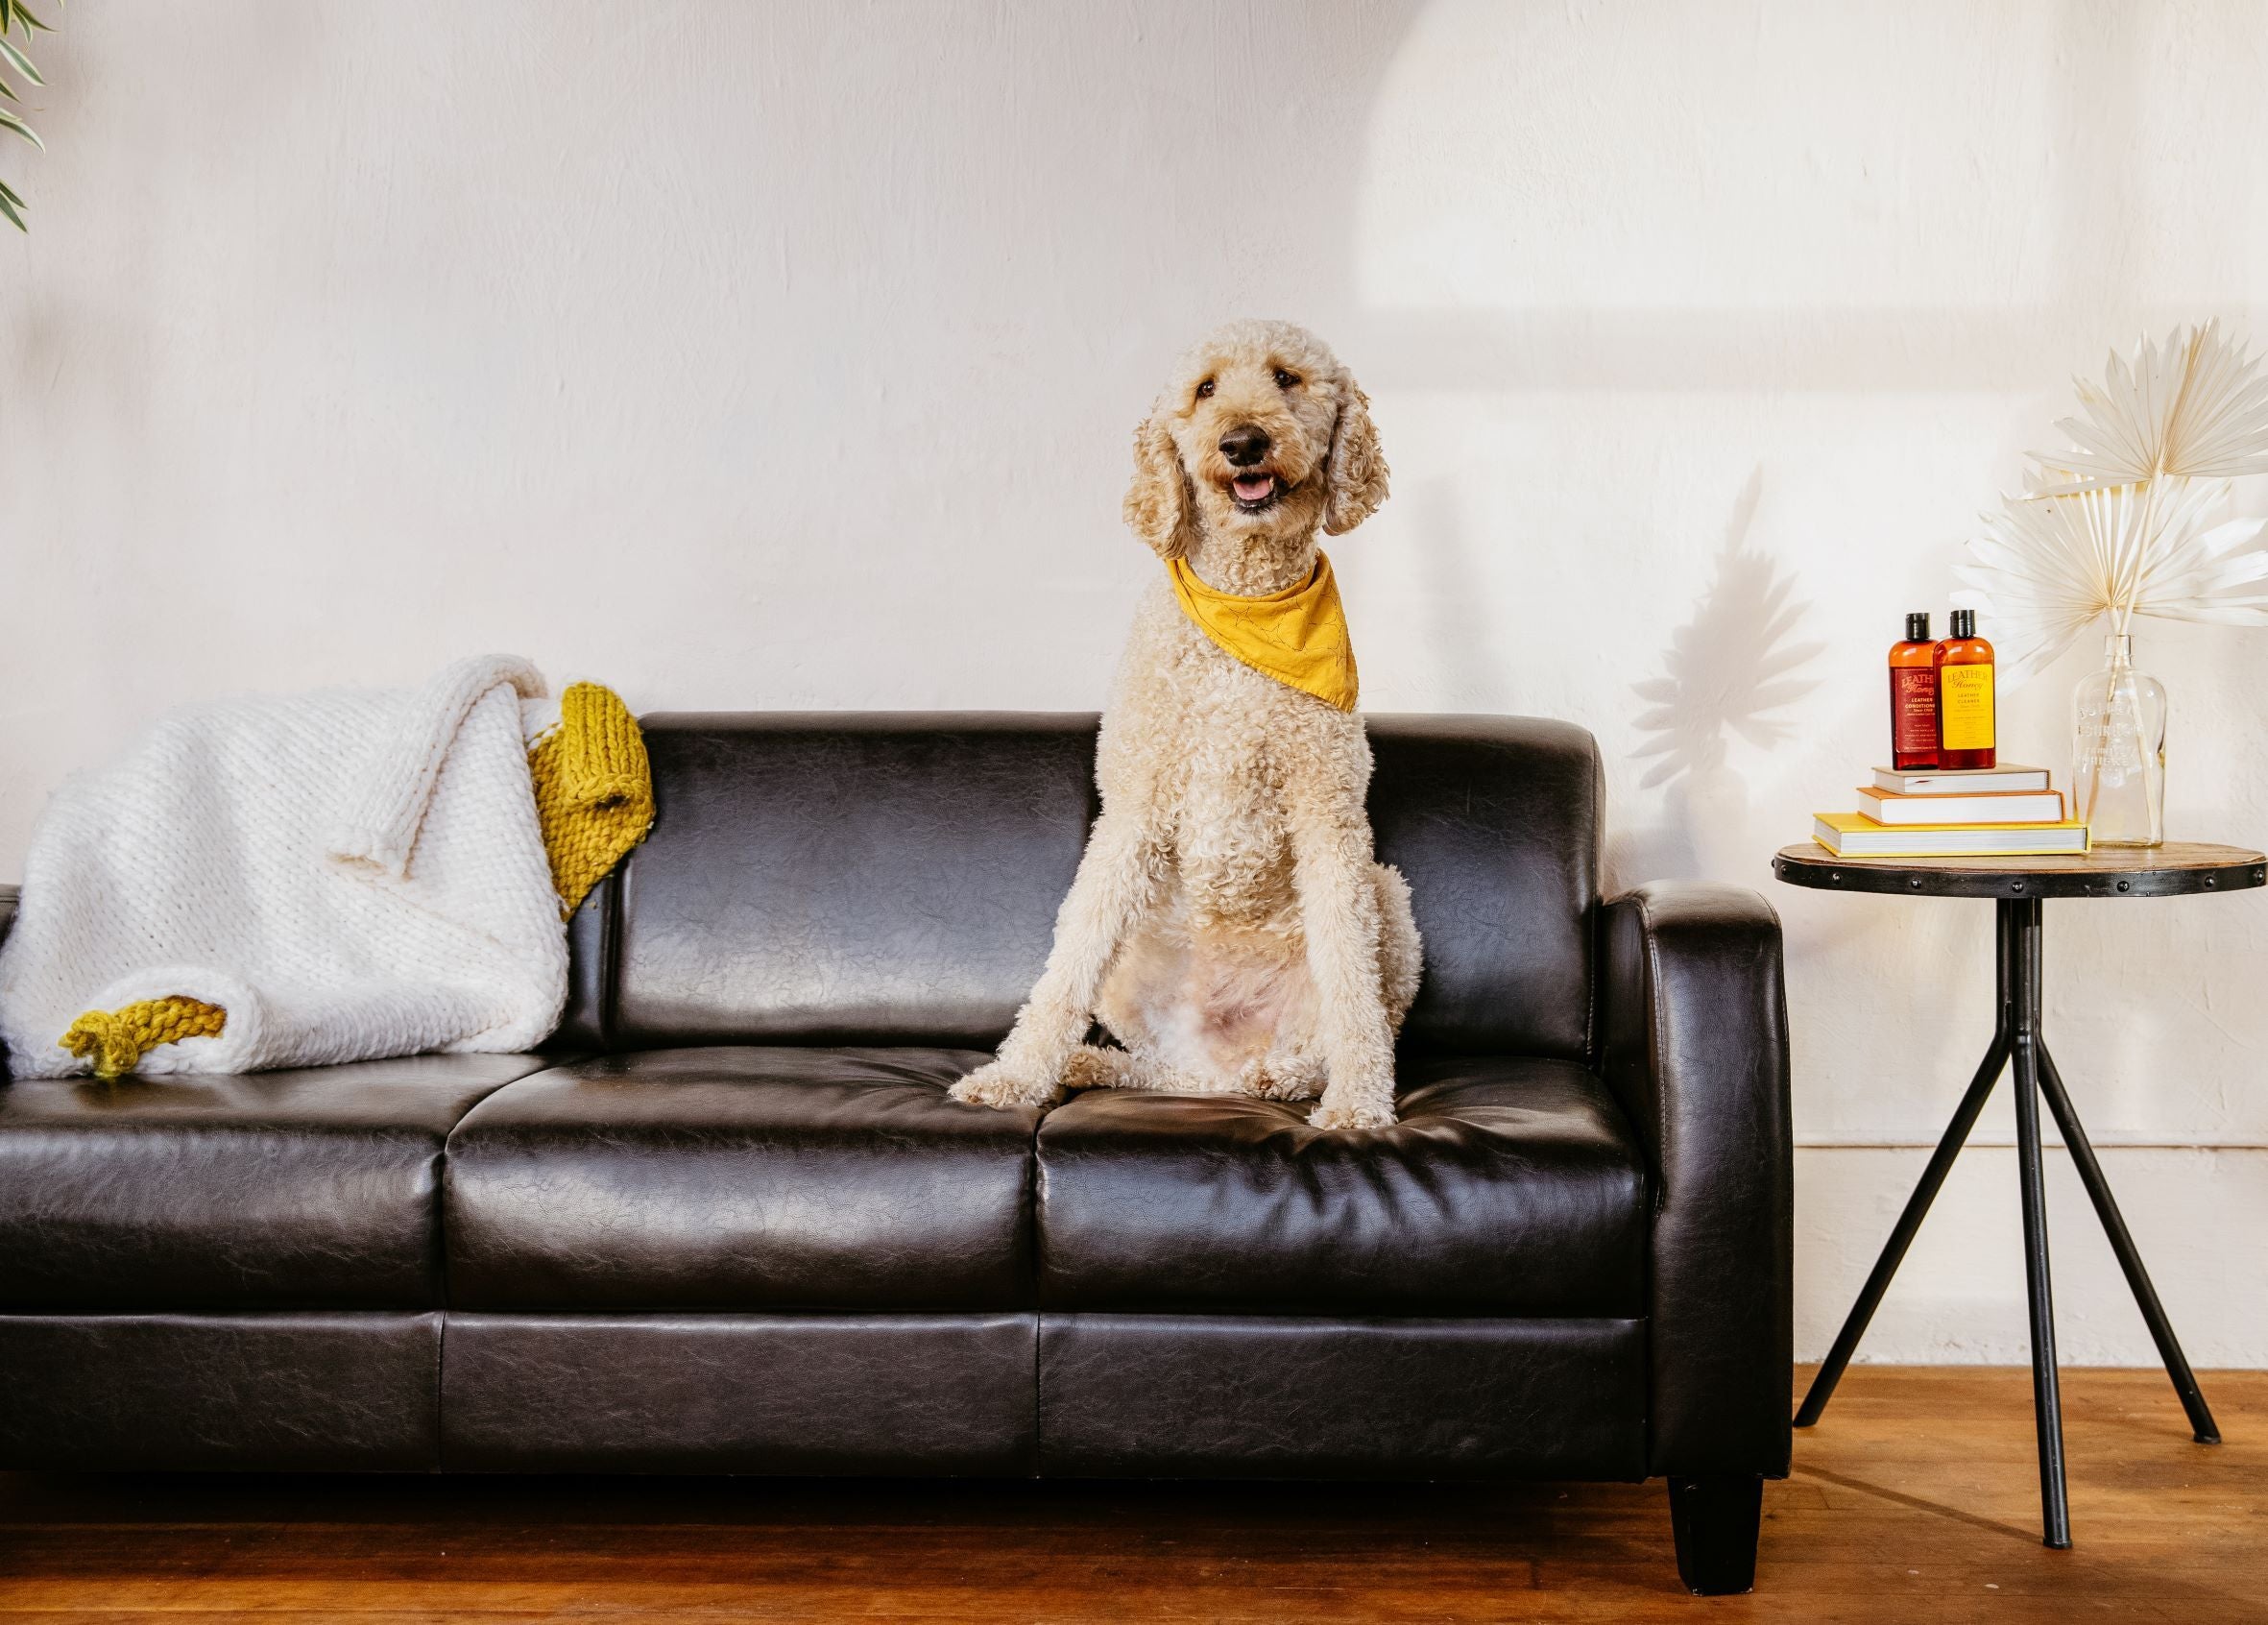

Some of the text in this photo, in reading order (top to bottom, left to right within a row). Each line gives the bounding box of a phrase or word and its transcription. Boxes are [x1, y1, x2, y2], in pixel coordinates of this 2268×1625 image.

[1902, 674, 1934, 689] LEATH
[1947, 669, 1988, 683] LEATHER
[1952, 680, 1983, 691] Honey
